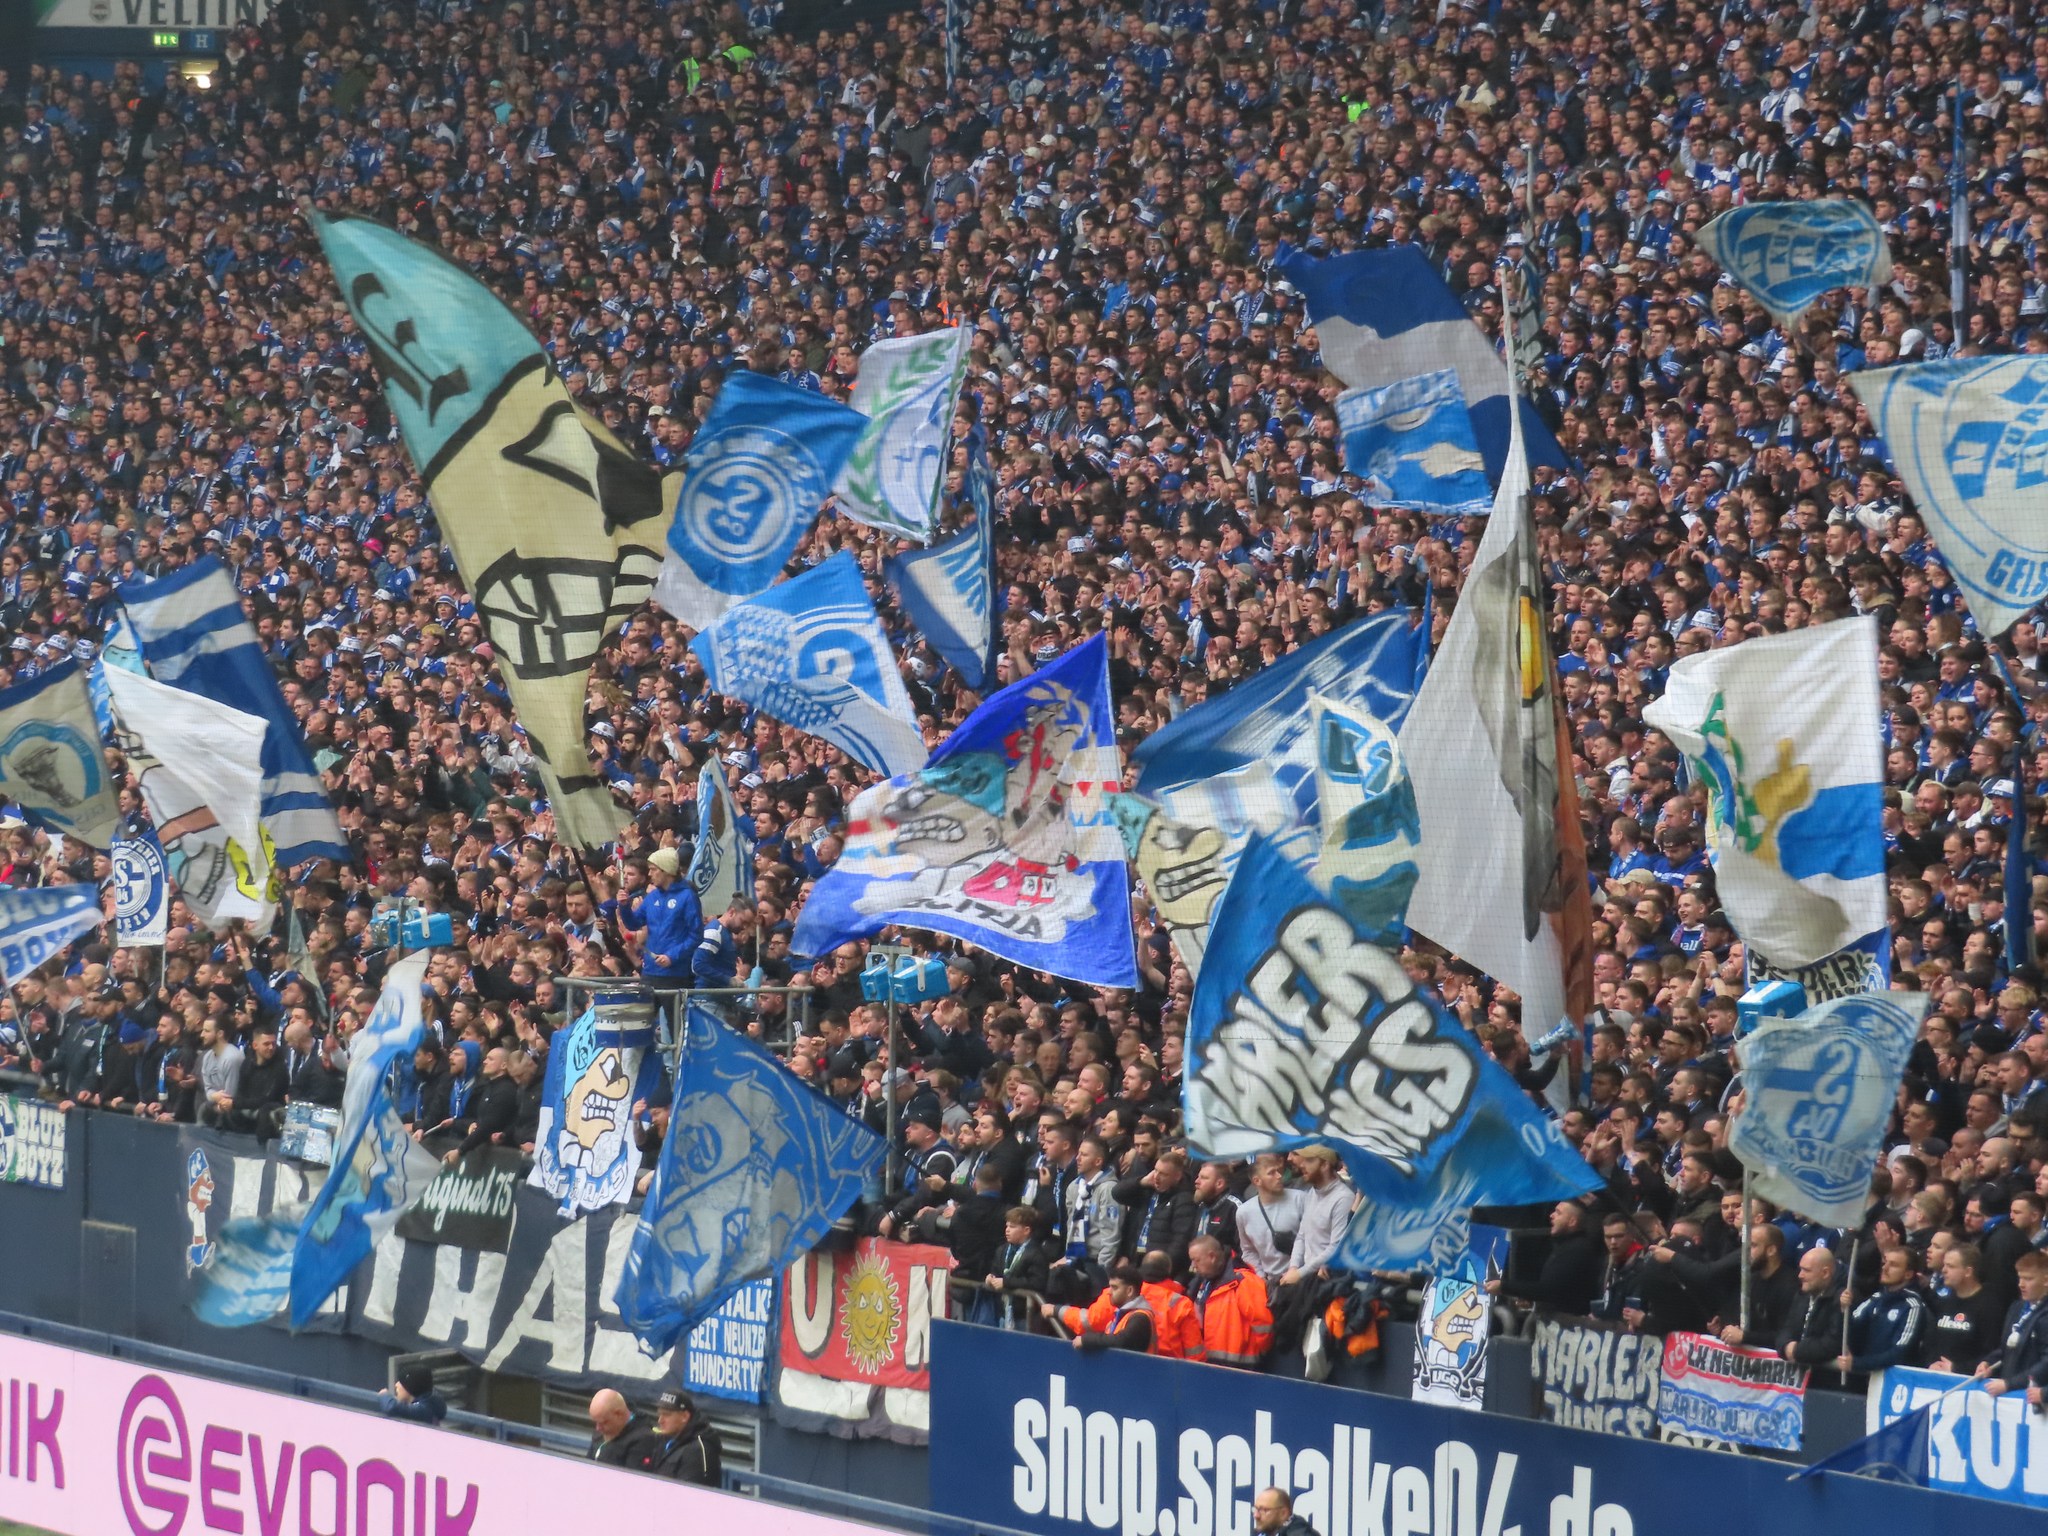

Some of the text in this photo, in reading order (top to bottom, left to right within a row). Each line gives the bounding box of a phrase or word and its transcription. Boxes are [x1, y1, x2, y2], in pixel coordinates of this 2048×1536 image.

[17, 1101, 66, 1150] BLUE
[16, 1141, 64, 1187] BOYZ
[492, 1171, 516, 1217] 75
[1531, 1320, 1664, 1412] MARLER
[200, 1423, 480, 1536] EVONIK
